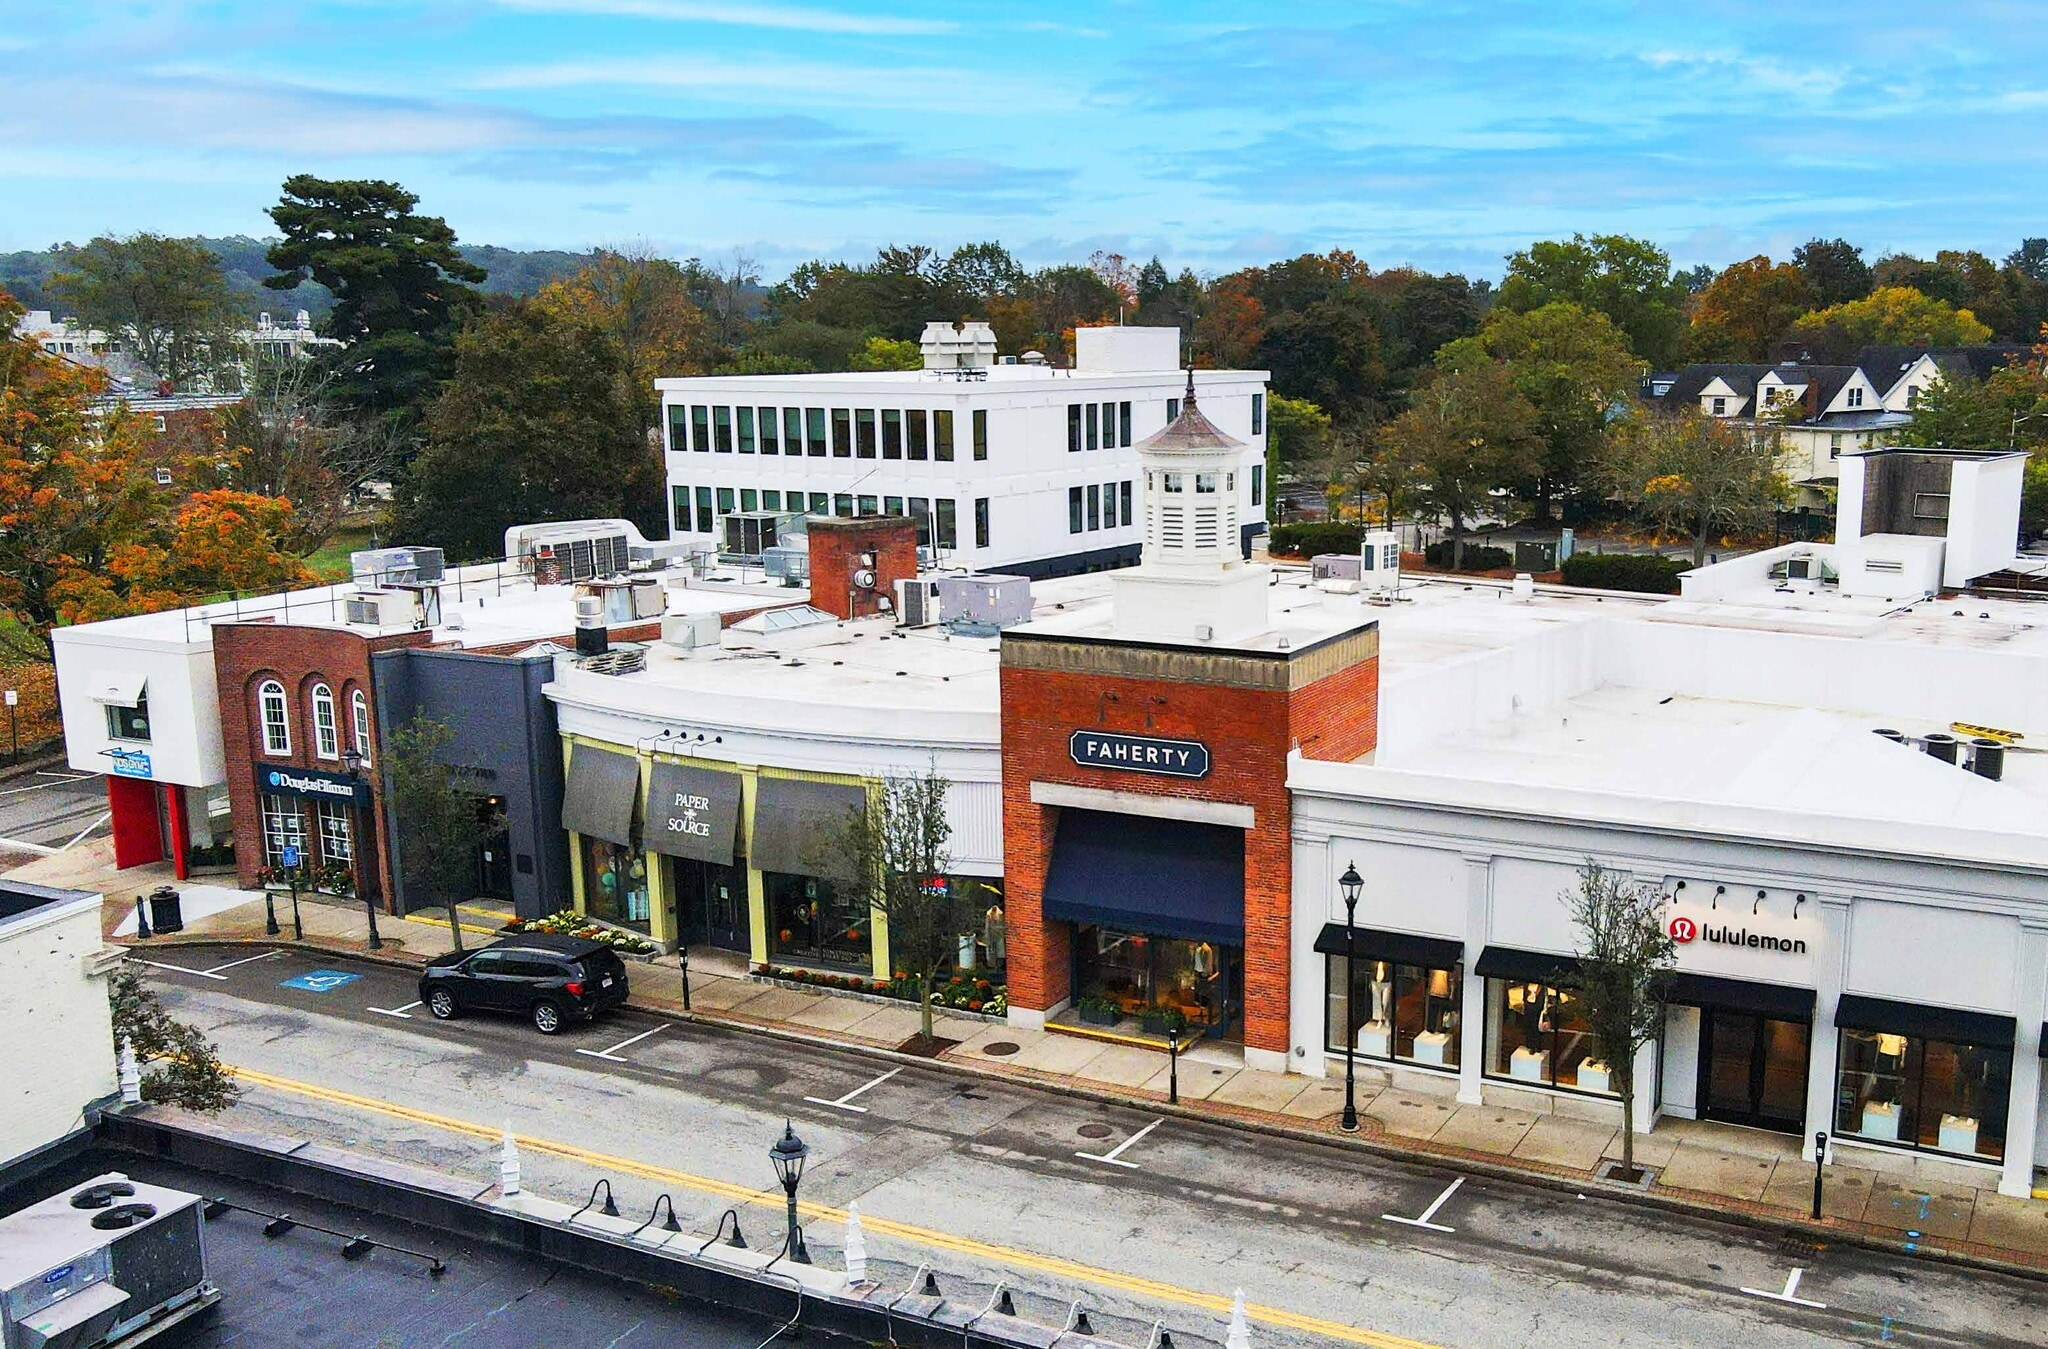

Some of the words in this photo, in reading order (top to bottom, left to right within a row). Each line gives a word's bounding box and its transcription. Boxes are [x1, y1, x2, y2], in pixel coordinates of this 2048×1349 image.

[1087, 740, 1190, 767] FAHERTY
[674, 793, 709, 811] PAPER
[667, 817, 711, 837] SOURCE
[1702, 923, 1806, 954] lululemon
